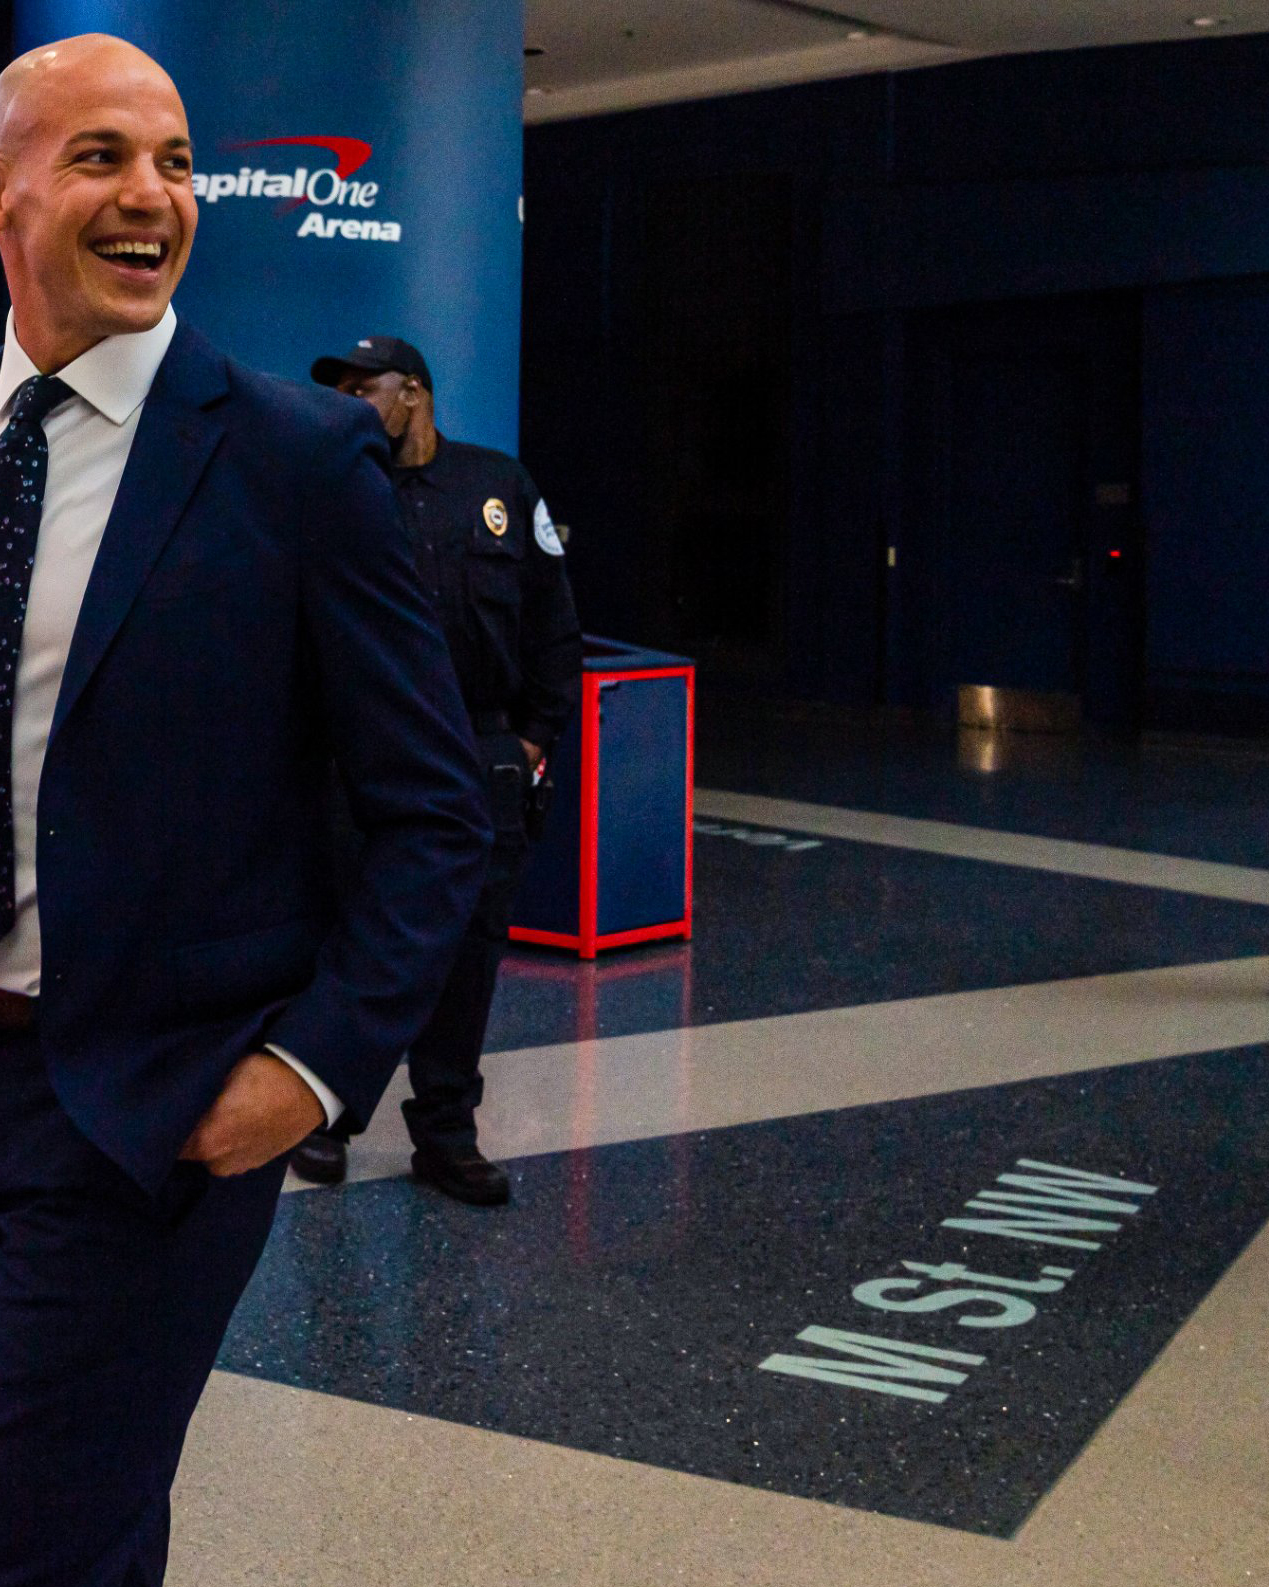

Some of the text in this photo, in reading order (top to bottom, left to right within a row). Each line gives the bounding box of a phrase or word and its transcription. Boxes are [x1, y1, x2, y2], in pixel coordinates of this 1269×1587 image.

[191, 167, 307, 203] apital
[297, 213, 401, 242] Arena
[757, 1157, 1160, 1403] M St. NW
